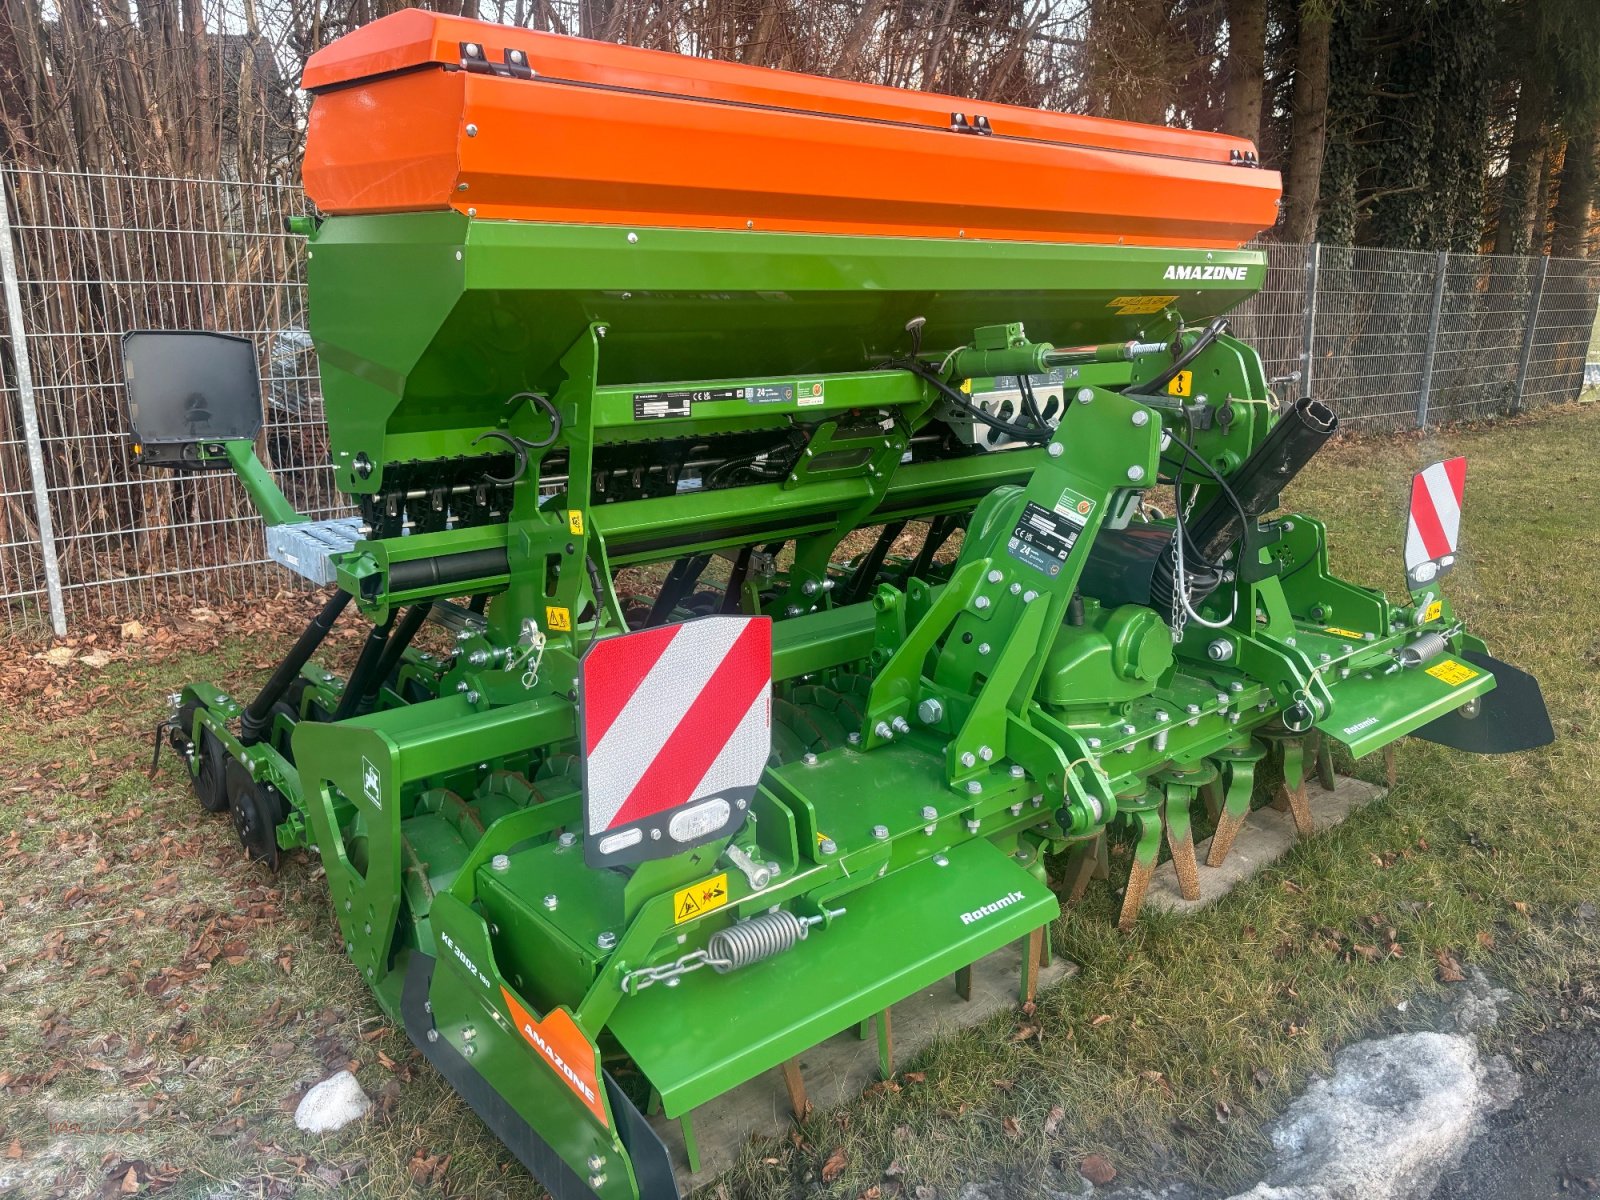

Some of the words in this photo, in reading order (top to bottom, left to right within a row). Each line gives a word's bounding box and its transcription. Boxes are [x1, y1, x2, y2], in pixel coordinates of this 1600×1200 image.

[1163, 265, 1248, 281] AMAZONE
[1019, 544, 1032, 556] 24
[1343, 717, 1380, 735] Rotamix
[960, 890, 1026, 925] Rotamix
[441, 931, 454, 950] KE
[454, 945, 478, 977] 3002
[524, 1023, 596, 1105] AMAZONE
